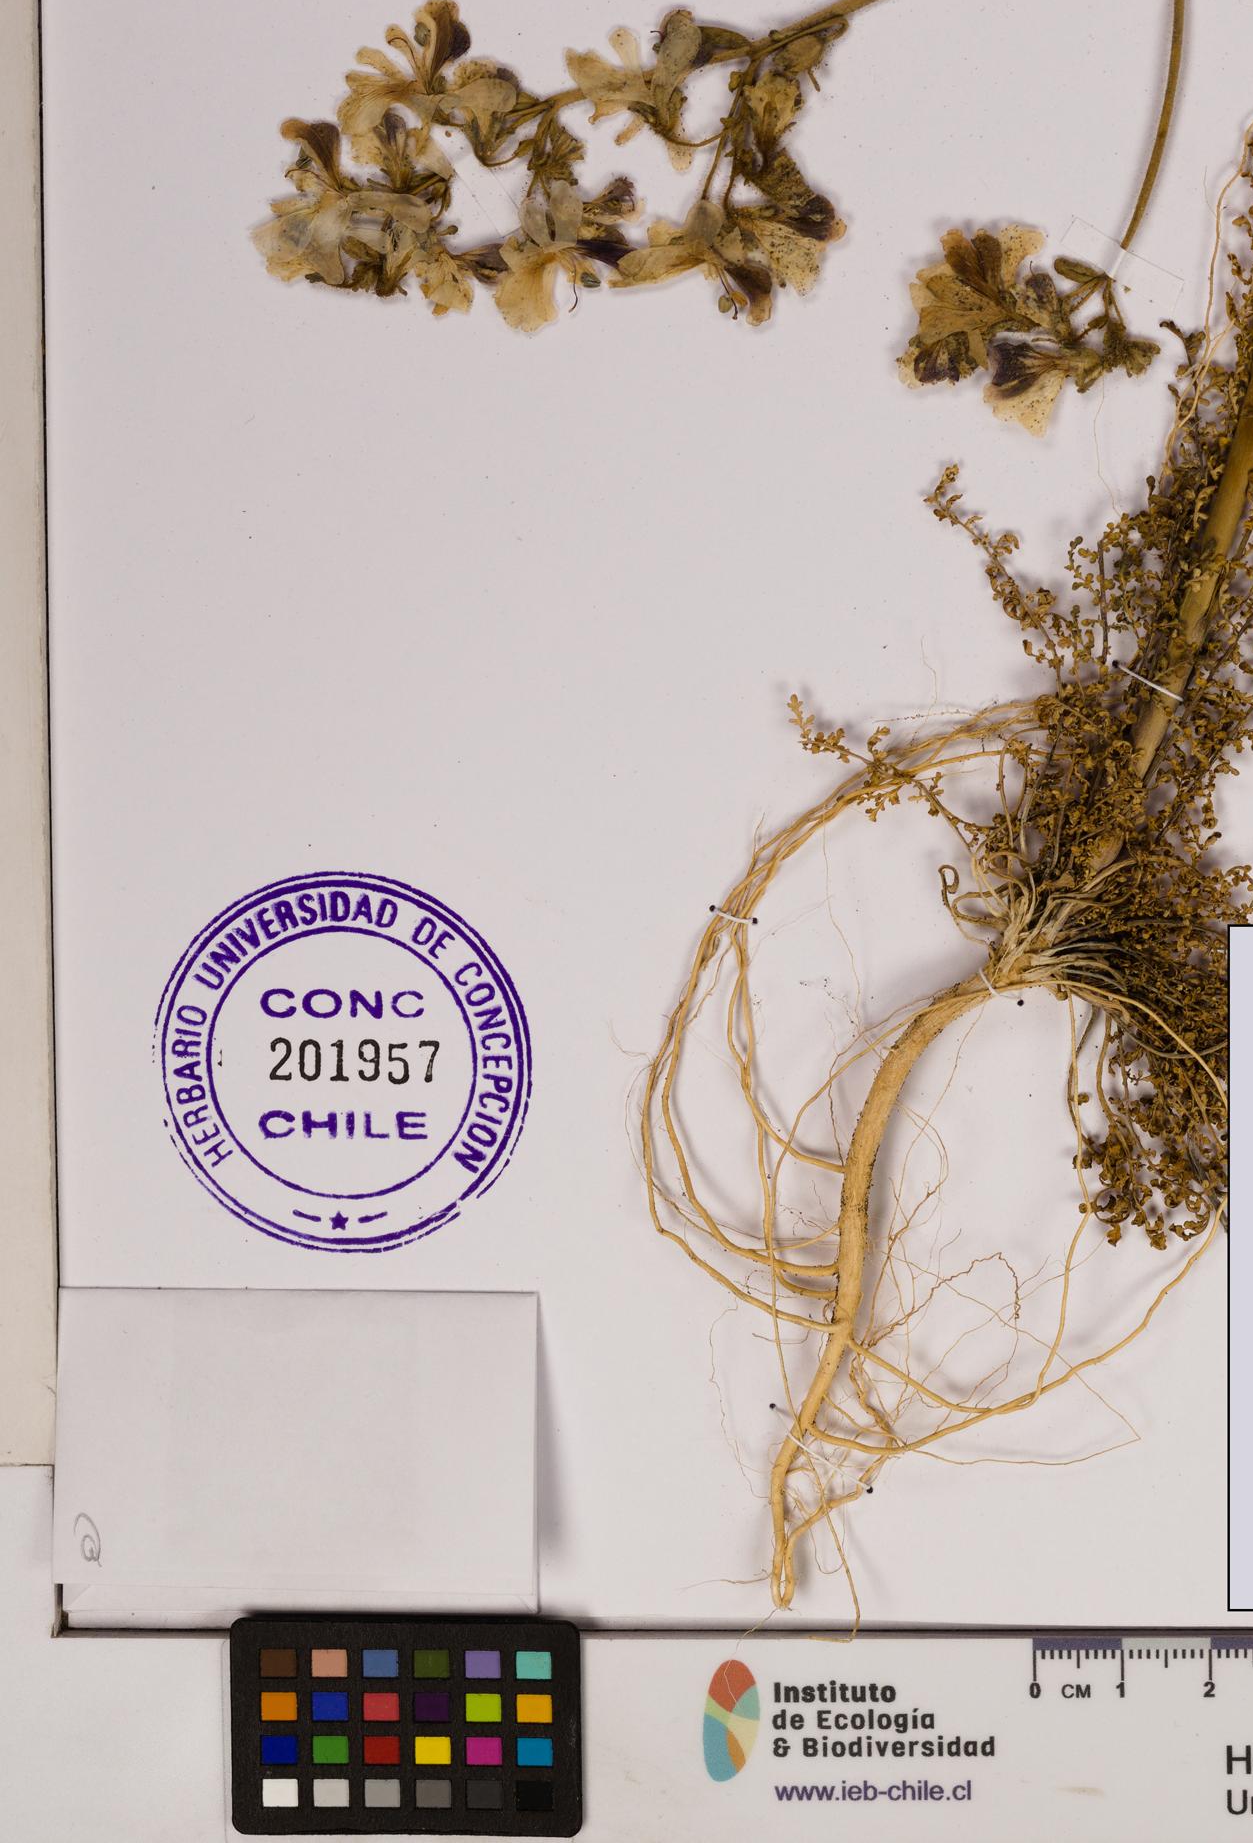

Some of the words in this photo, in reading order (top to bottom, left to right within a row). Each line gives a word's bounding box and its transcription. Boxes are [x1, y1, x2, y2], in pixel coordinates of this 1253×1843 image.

[192, 890, 400, 992] UNIVERSIDAD
[410, 915, 457, 960] DE
[259, 987, 425, 1020] CONC
[269, 1036, 440, 1086] 201957
[452, 960, 514, 1175] CONCEPCION
[172, 1002, 236, 1170] HERBARIO
[257, 1109, 429, 1141] CHILE
[773, 1679, 897, 1704] Instituto
[1029, 1679, 1042, 1699] 0
[1061, 1683, 1092, 1699] CM
[1115, 1681, 1126, 1699] 1
[1203, 1679, 1216, 1698] 2
[771, 1708, 805, 1731] de
[815, 1708, 937, 1735] Ecología
[772, 1737, 792, 1758] &
[802, 1734, 995, 1758] Biodiversidad
[774, 1779, 972, 1802] www.ieb-chile.cl
